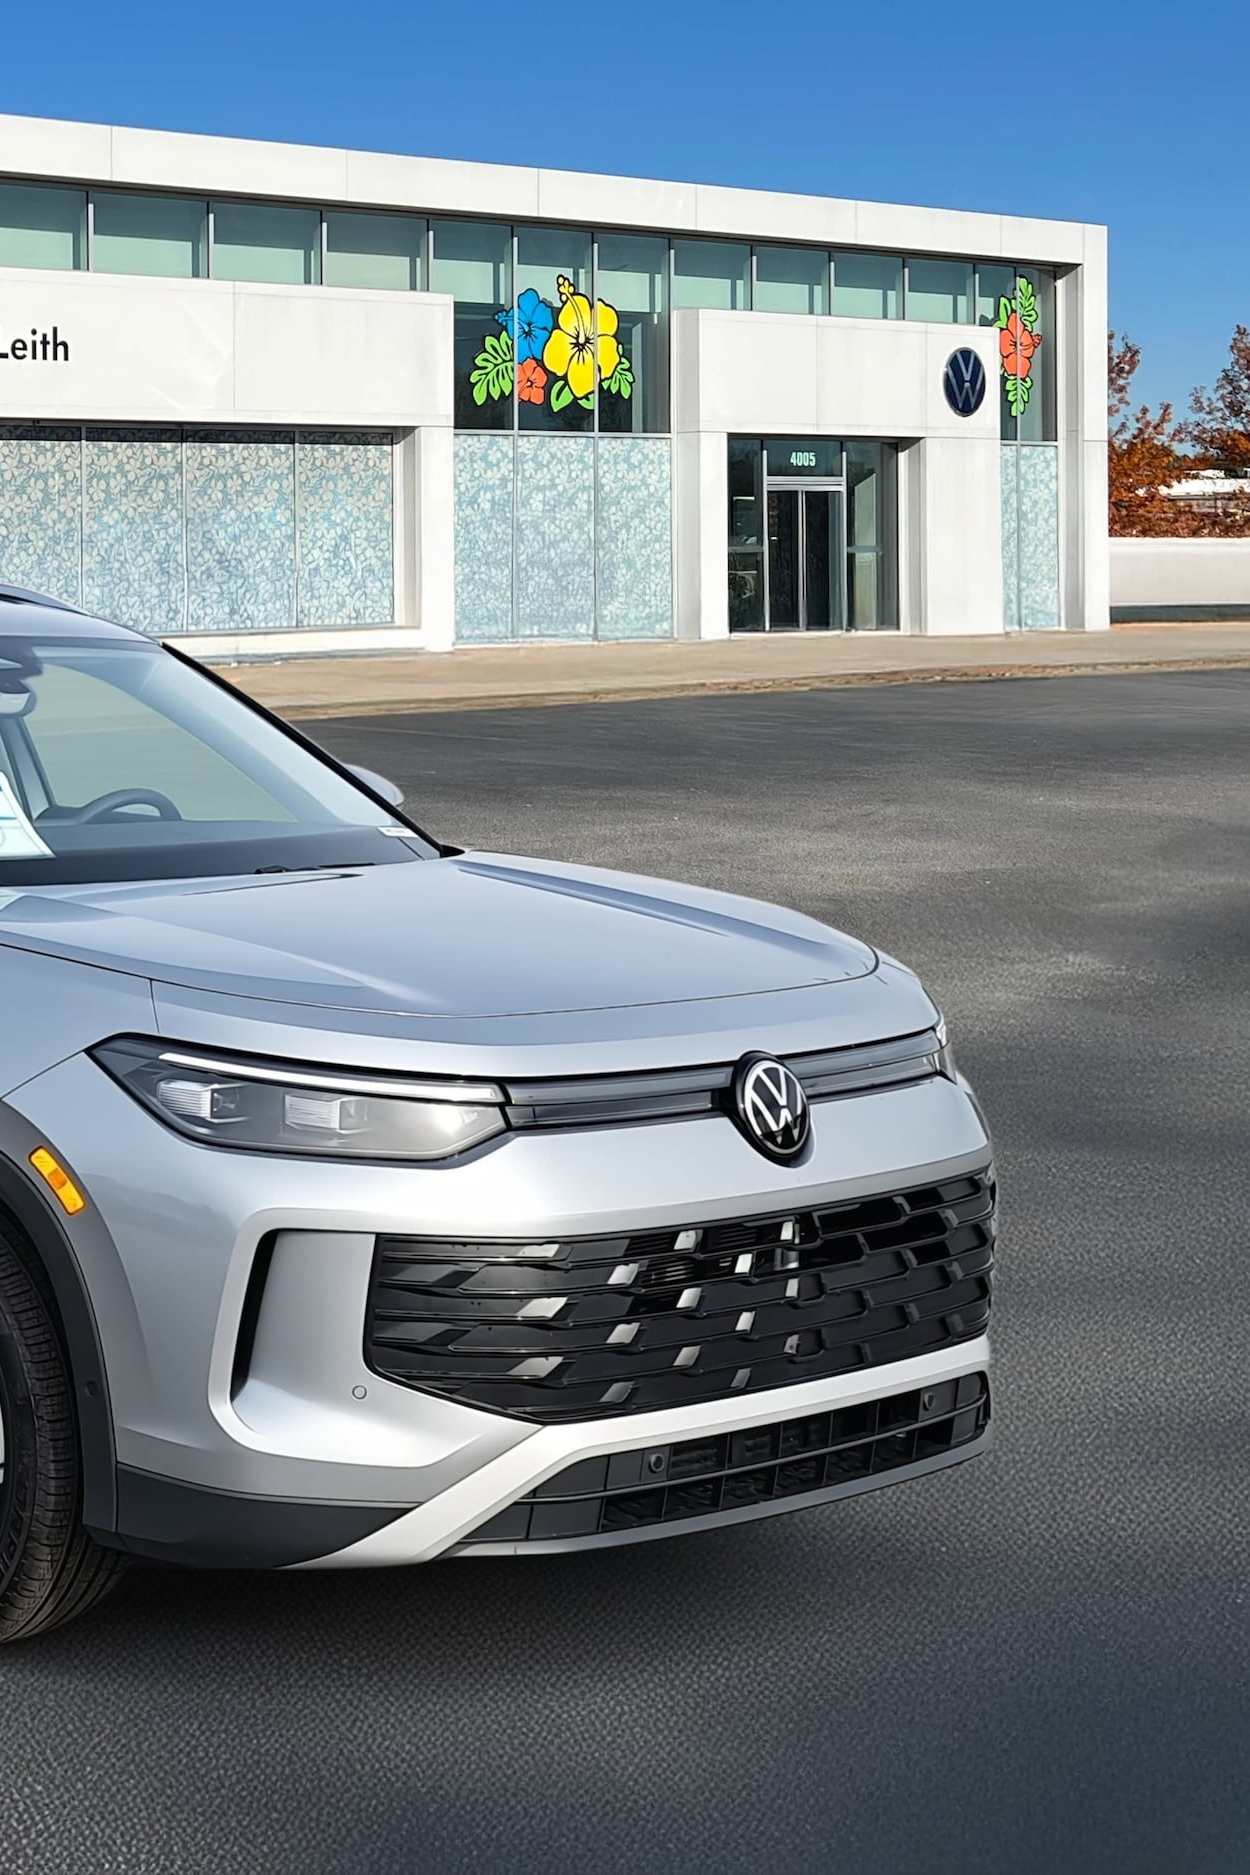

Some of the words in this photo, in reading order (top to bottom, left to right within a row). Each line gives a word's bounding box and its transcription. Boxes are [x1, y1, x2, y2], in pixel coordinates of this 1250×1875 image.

[945, 348, 986, 414] VW
[790, 452, 815, 466] 4005
[746, 1063, 806, 1148] VW
